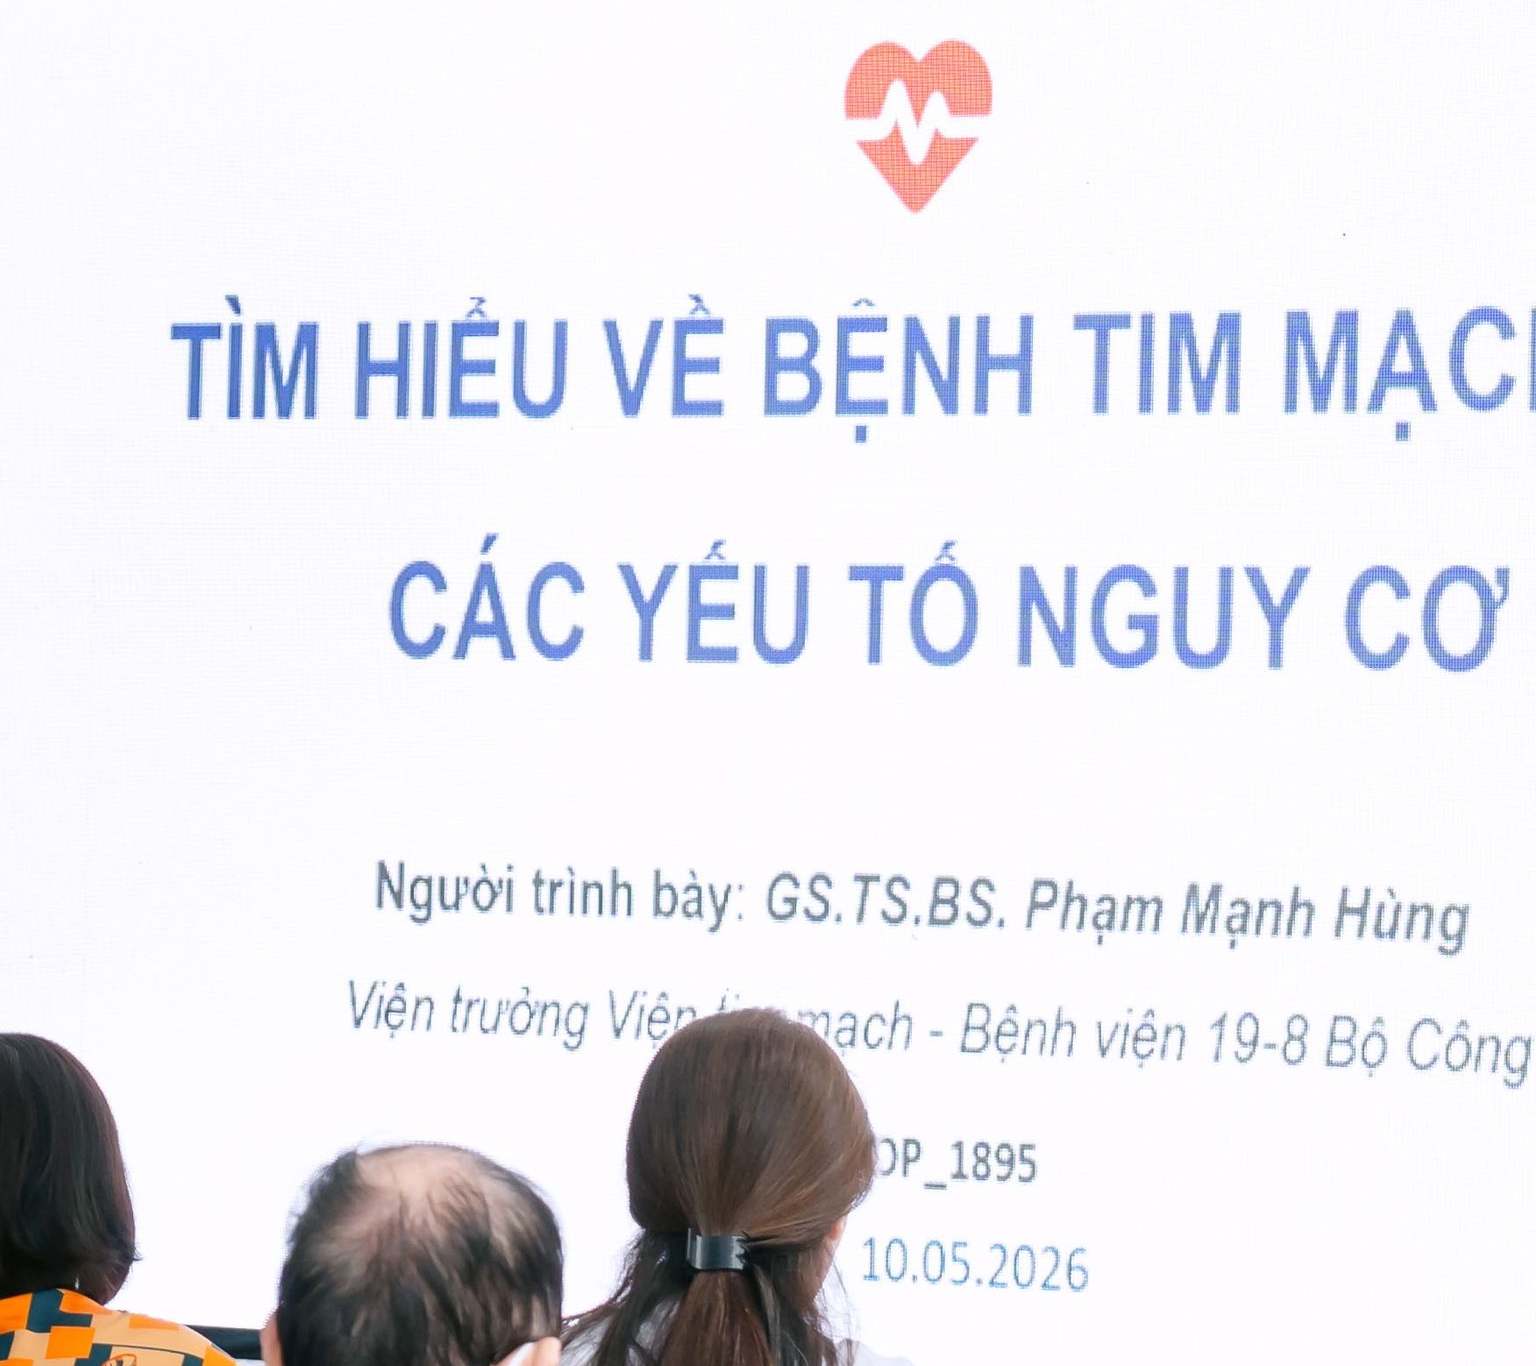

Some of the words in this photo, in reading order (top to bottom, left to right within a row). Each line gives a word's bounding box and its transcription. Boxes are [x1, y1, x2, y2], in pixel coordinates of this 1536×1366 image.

[170, 293, 320, 421] TÌM
[354, 295, 569, 420] HIỂU
[602, 292, 725, 419] VỀ
[763, 295, 1035, 444] BỆNH
[1072, 310, 1242, 416] TIM
[388, 532, 586, 662] CÁC
[617, 539, 810, 665] YẾU
[848, 539, 979, 668] TỐ
[1017, 564, 1311, 671] NGUY
[1344, 564, 1511, 673] CƠ
[375, 859, 515, 926] Người
[532, 866, 633, 917] trình
[652, 869, 744, 933] bày:
[766, 872, 1006, 929] GS.TS.BS.
[1025, 879, 1164, 947] Phạm
[1180, 883, 1316, 950] Mạnh
[1334, 886, 1471, 956] Hùng
[348, 979, 436, 1040] Viện
[450, 984, 590, 1052] trưởng
[960, 1002, 1077, 1064] Bệnh
[1096, 1007, 1187, 1068] viện
[1210, 1011, 1310, 1067] 19-8
[1325, 1015, 1389, 1077] Bộ
[1406, 1017, 1533, 1090] Công
[862, 1236, 1090, 1293] 10.05.2026
